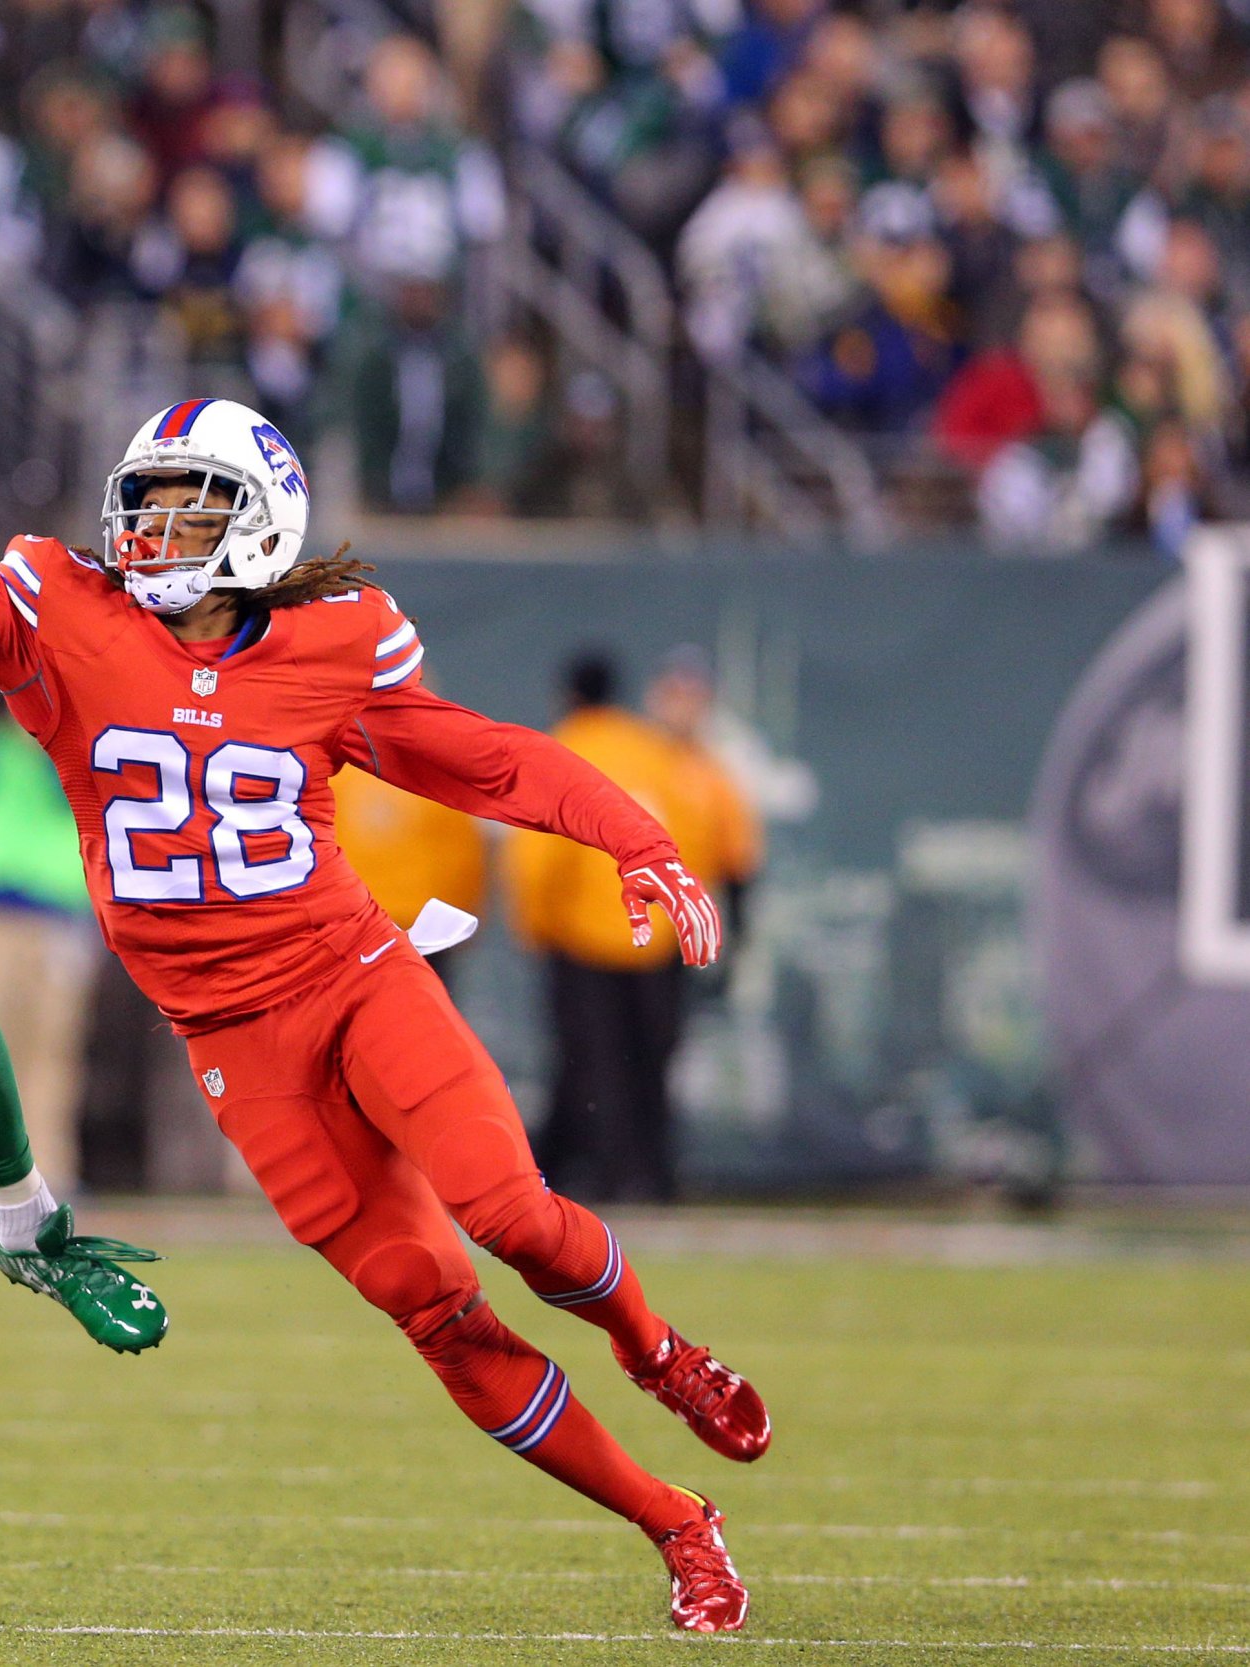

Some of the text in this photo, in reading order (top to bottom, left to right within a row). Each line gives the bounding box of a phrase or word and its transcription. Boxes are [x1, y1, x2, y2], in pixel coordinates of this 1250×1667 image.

[196, 679, 212, 692] NFL
[172, 707, 223, 728] BILLS
[91, 724, 317, 904] 28
